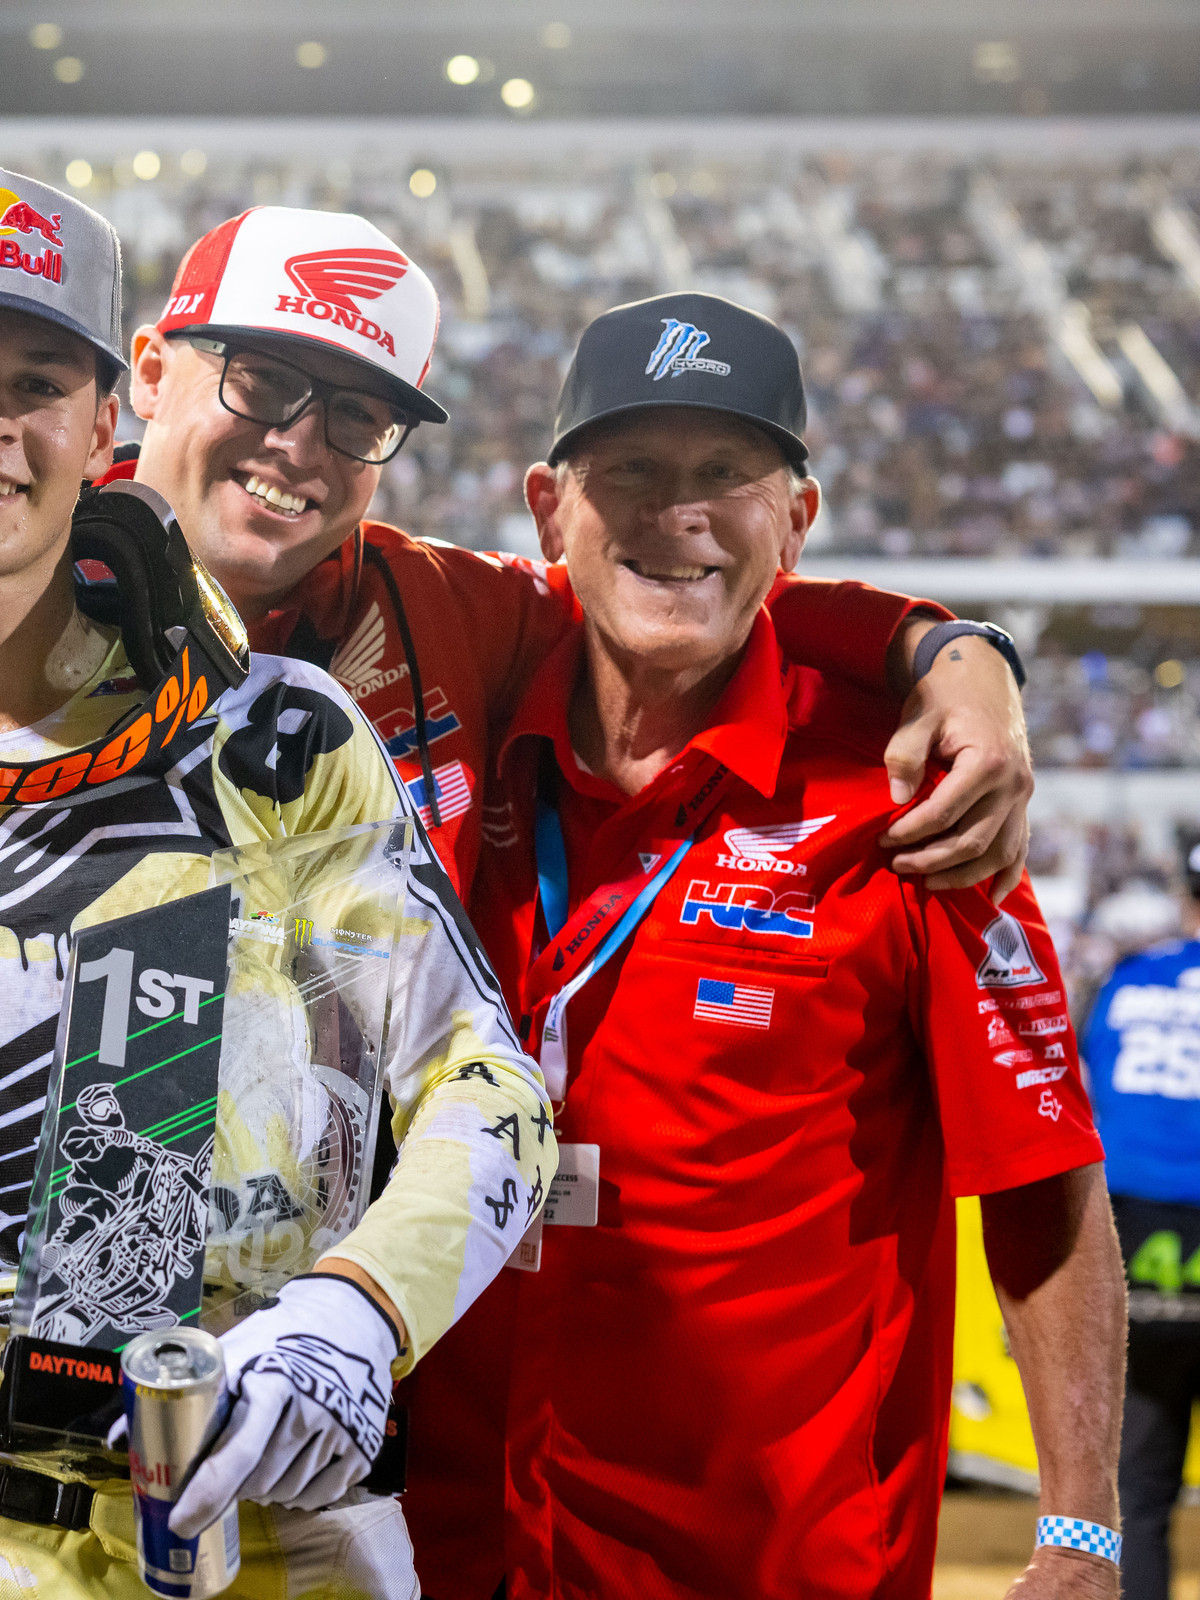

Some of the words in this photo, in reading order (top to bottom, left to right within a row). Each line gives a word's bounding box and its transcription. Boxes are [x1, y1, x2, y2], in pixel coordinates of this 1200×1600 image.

[275, 295, 396, 357] HONDA
[674, 359, 728, 375] HYDRO
[715, 853, 808, 876] HONDA
[229, 918, 285, 939] AYTONA
[564, 894, 623, 955] HONDA
[679, 879, 817, 939] HRC
[331, 928, 373, 942] MONSTER
[79, 947, 215, 1068] 1ST
[29, 1352, 114, 1385] DAYTONA
[252, 1352, 384, 1462] ASTARS
